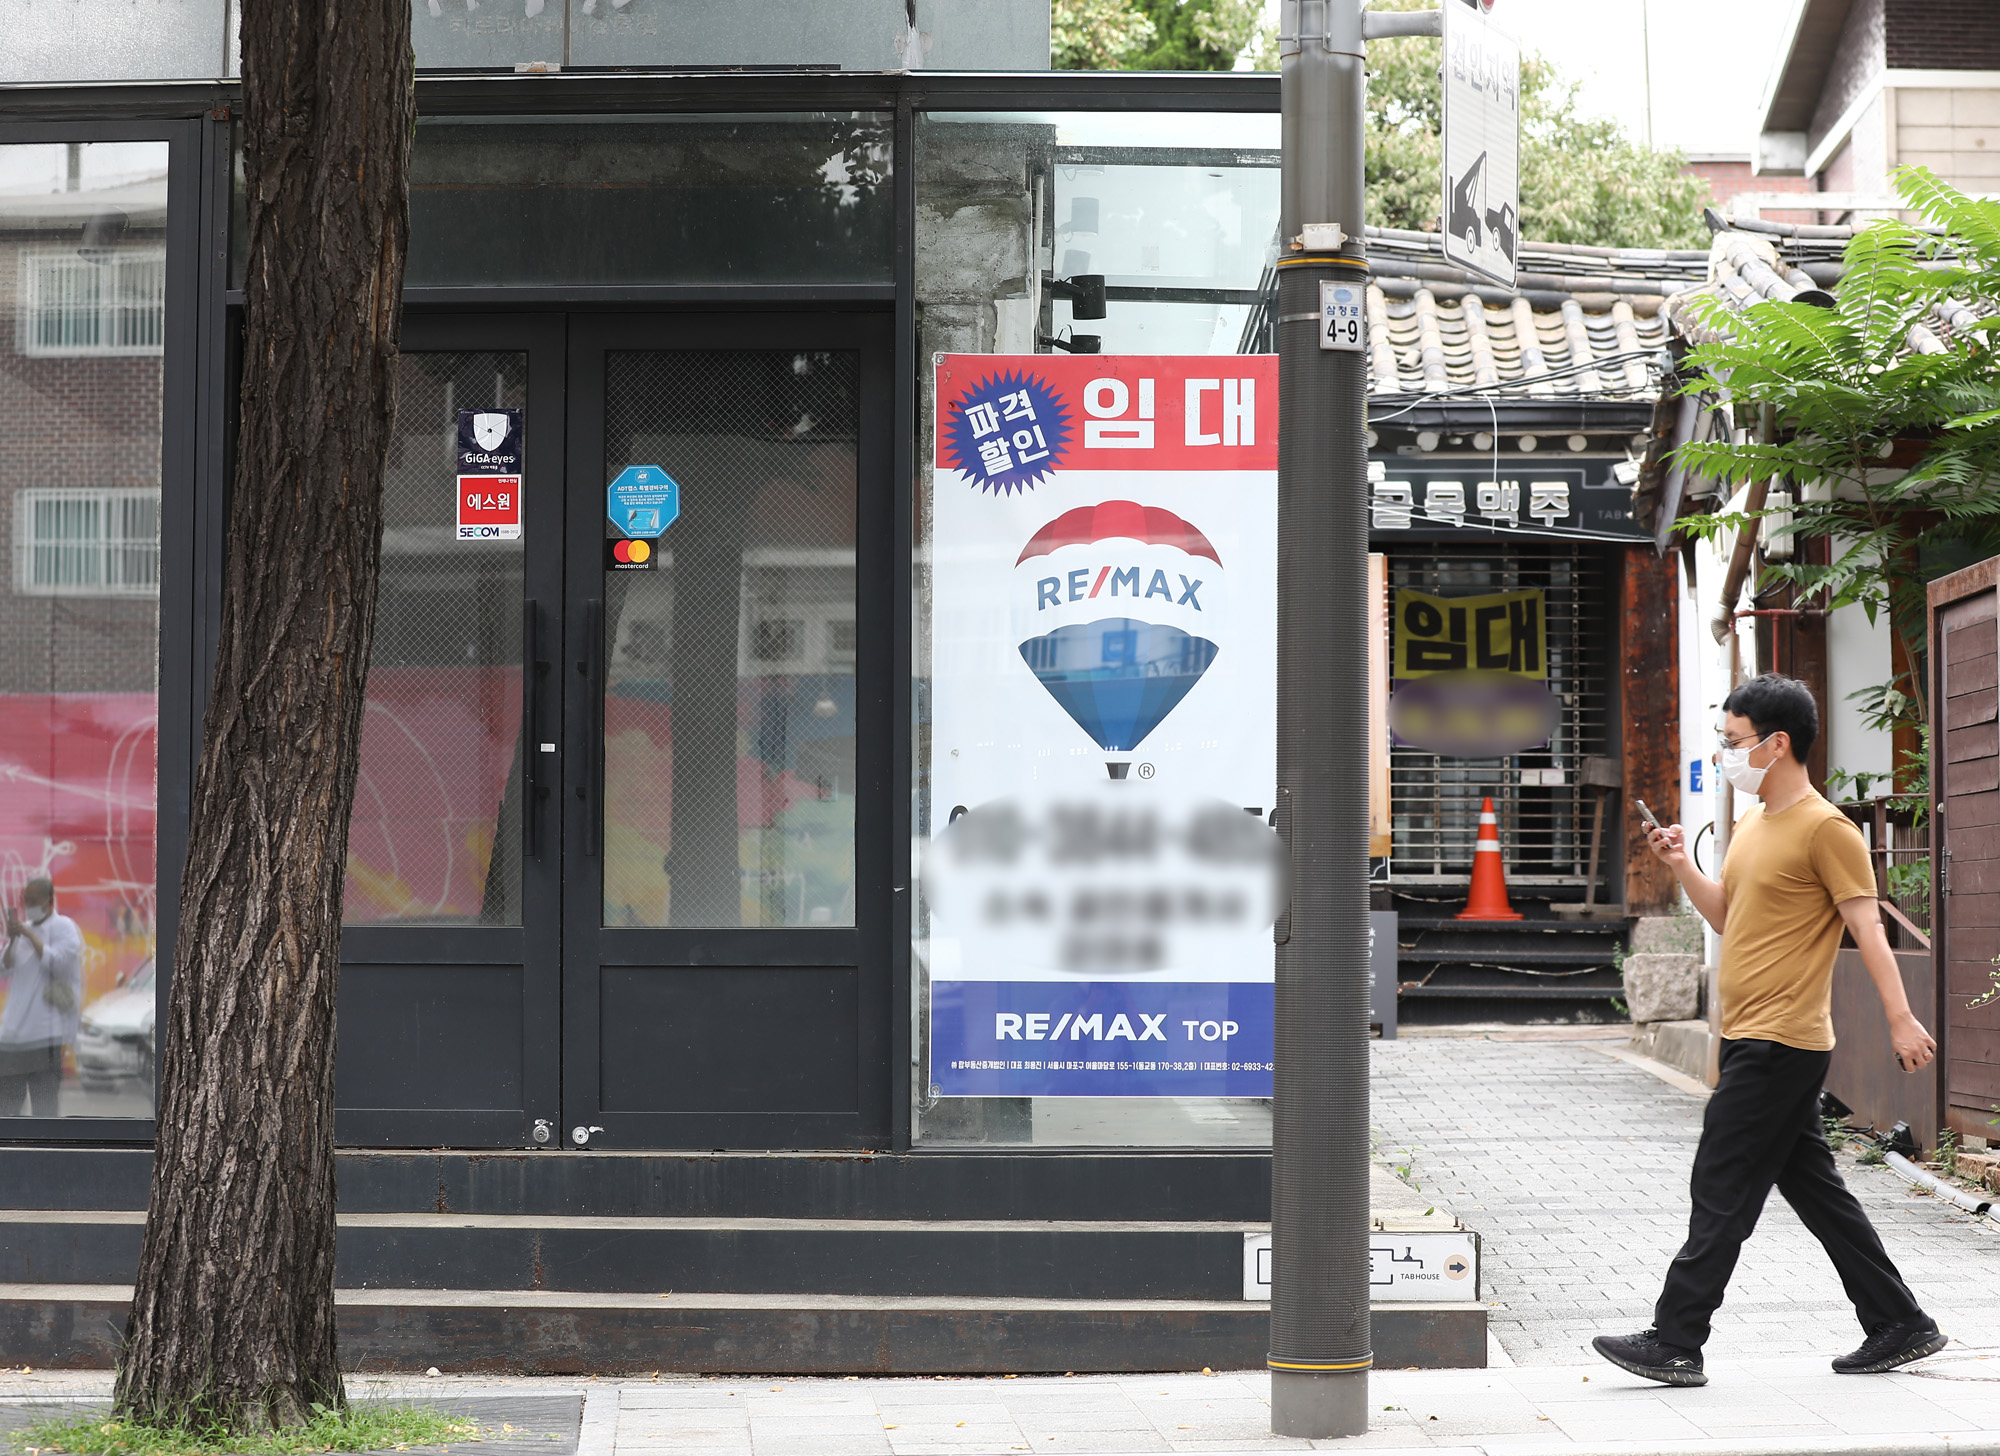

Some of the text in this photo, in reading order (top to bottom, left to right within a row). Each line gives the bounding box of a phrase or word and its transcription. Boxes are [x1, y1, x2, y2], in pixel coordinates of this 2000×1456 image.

[1451, 29, 1515, 111] 견인지역
[1326, 305, 1359, 317] 삼청로
[1327, 319, 1358, 343] 4-9
[964, 388, 1036, 440] 파격
[978, 425, 1050, 477] 할인
[466, 493, 511, 511] 에스원
[1372, 479, 1571, 529] 골목맥주
[460, 527, 500, 537] SECOM
[1036, 565, 1203, 612] RE/MAX
[1404, 597, 1540, 673] 임대
[995, 1013, 1240, 1042] RE/MAX TOP
[1231, 1062, 1275, 1071] 02-6933-42
